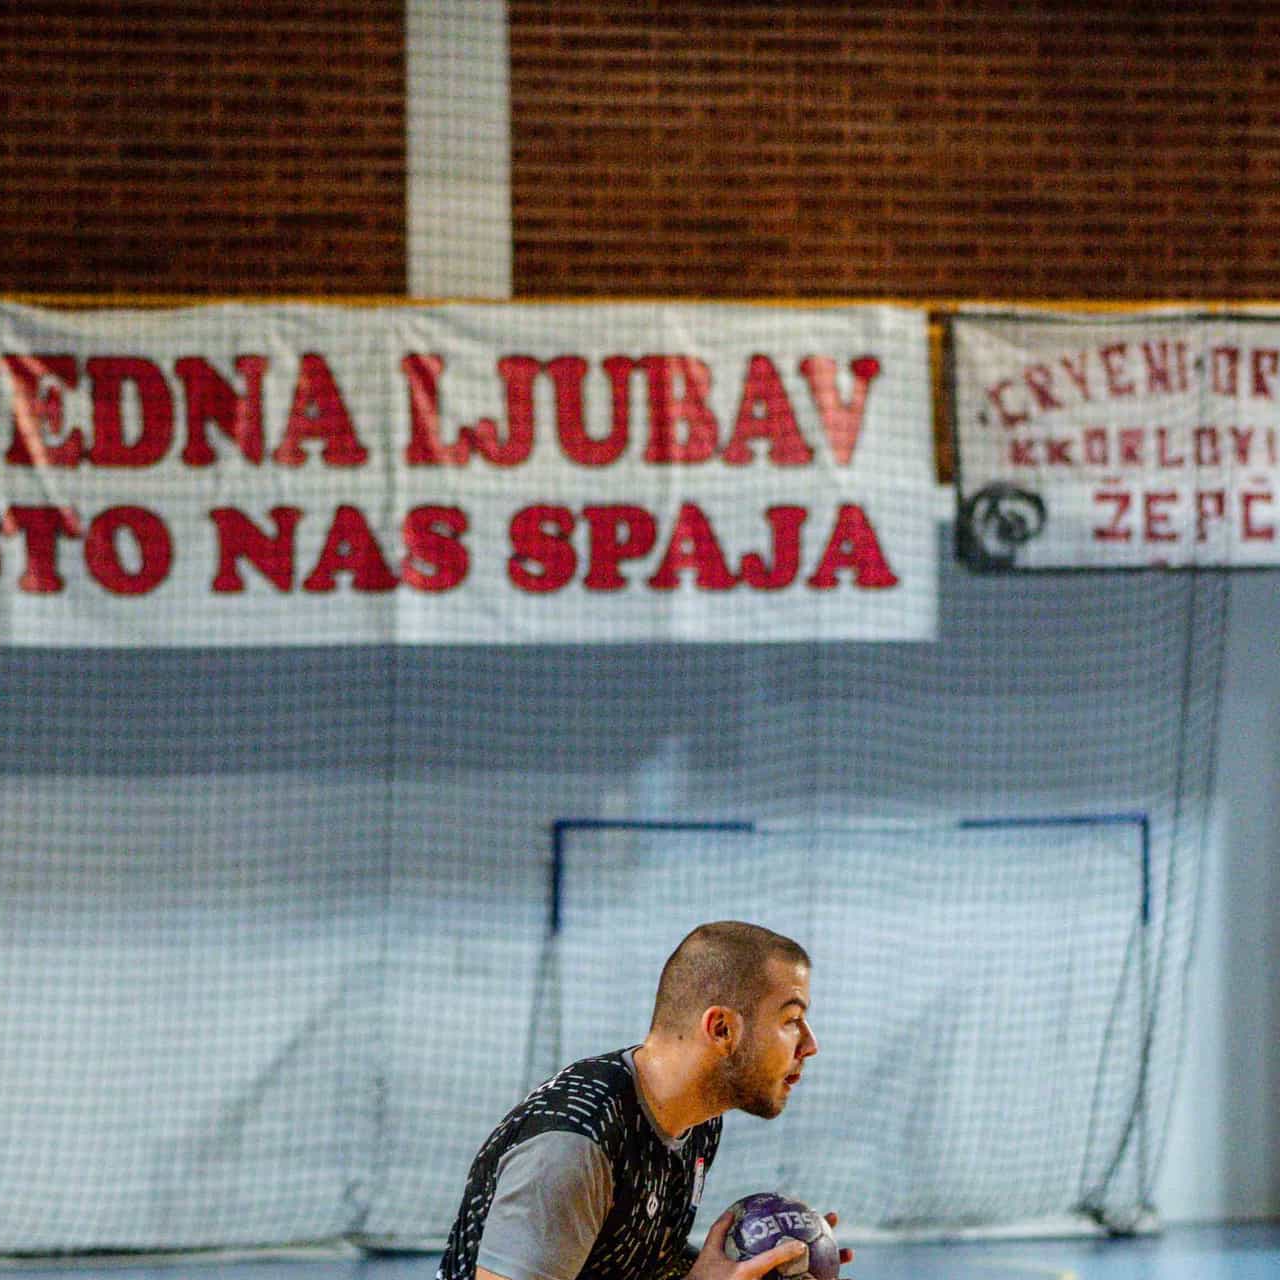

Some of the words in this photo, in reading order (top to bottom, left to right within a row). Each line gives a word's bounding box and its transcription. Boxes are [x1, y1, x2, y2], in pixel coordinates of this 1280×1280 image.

[400, 352, 882, 469] LJUBAV
[210, 504, 471, 594] NAS
[506, 502, 899, 594] SPAJA
